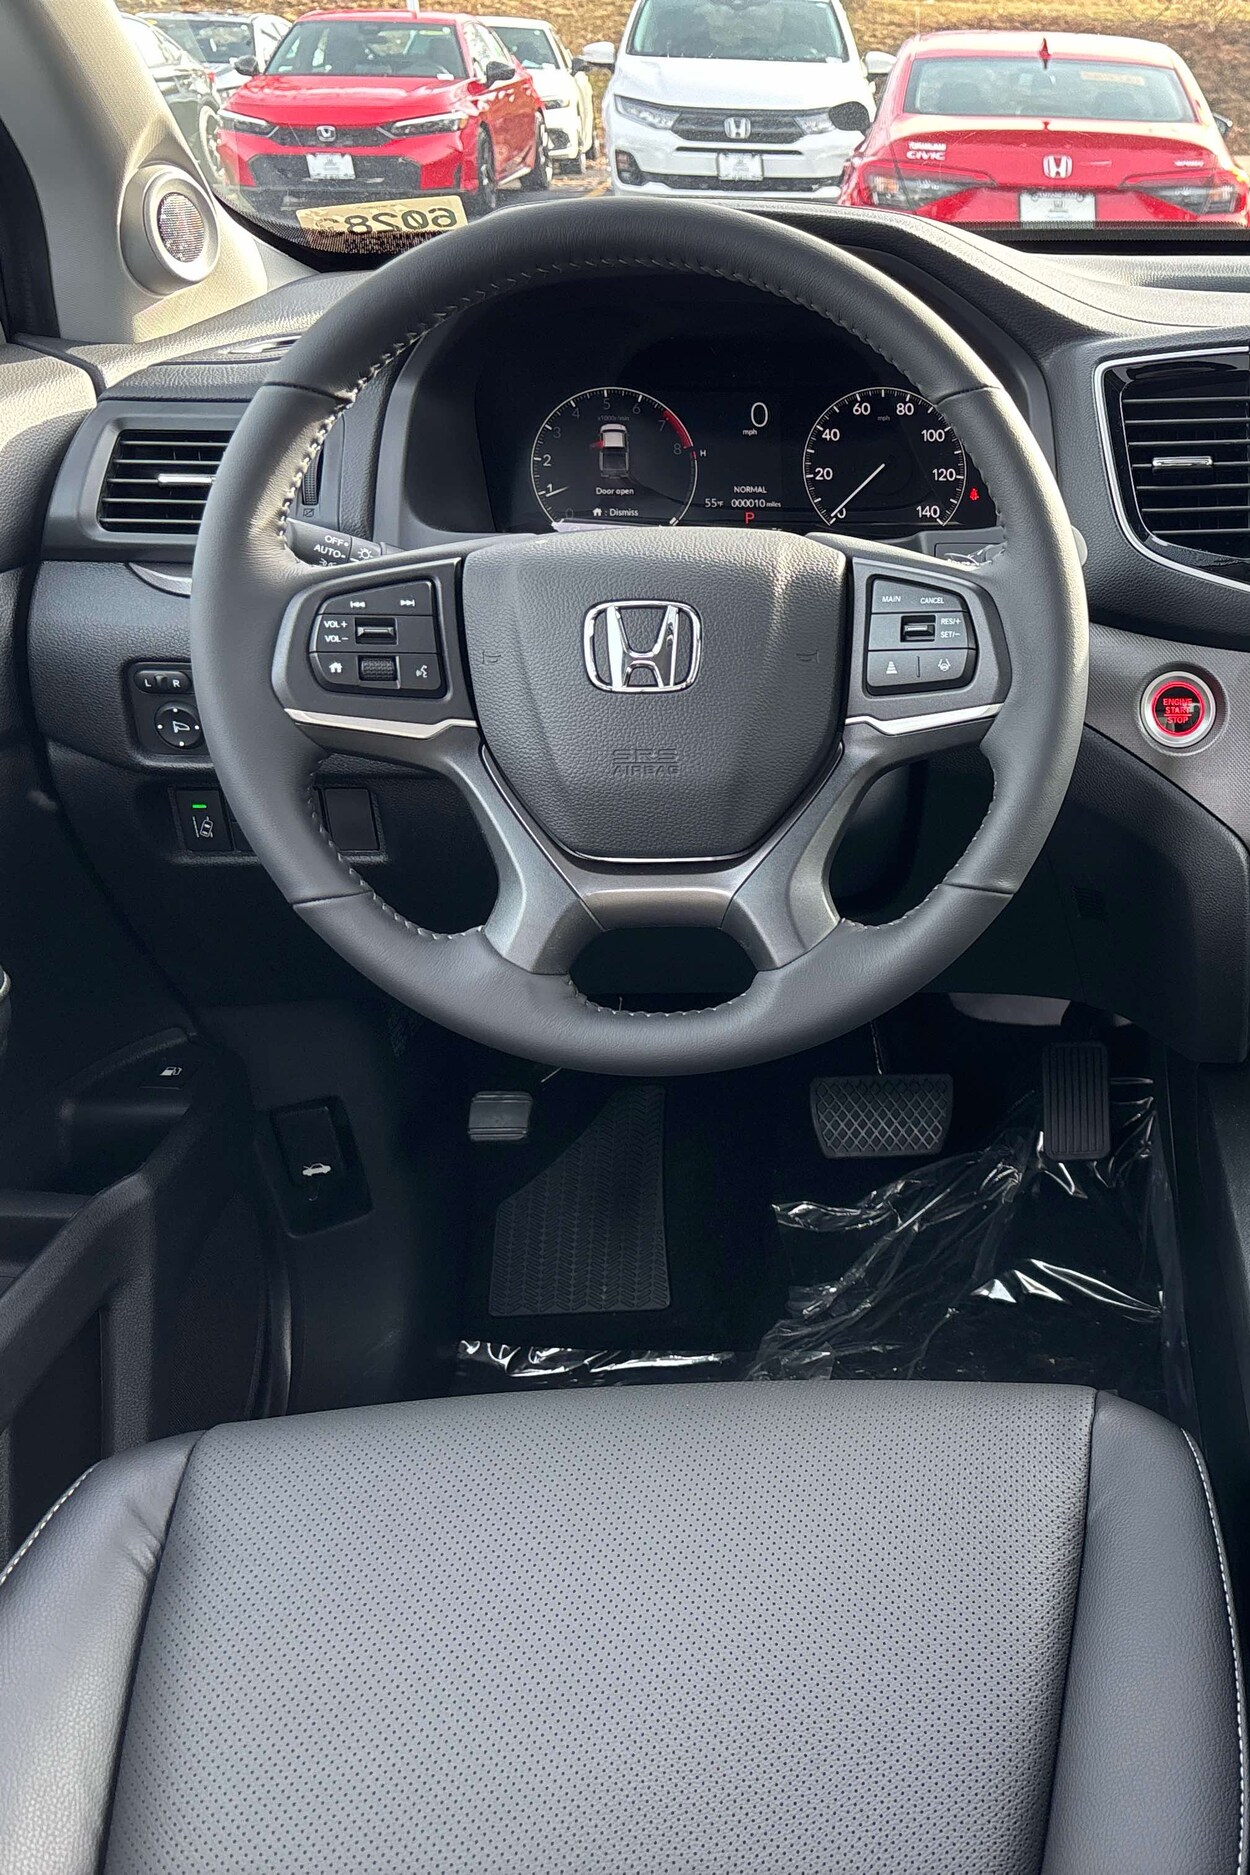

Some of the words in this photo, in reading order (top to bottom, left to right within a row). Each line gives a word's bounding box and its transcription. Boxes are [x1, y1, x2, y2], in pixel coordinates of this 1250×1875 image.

[906, 150, 946, 160] CIVIC
[603, 399, 610, 410] 5
[632, 402, 640, 413] 6
[853, 404, 871, 416] 60
[896, 404, 914, 416] 80
[572, 408, 580, 418] 4
[750, 402, 768, 427] 0
[658, 420, 666, 431] 7
[553, 427, 561, 438] 3
[822, 429, 840, 441] 40
[921, 430, 945, 442] 100
[674, 444, 682, 455] 8
[543, 454, 552, 466] 2
[815, 468, 833, 480] 20
[932, 468, 956, 481] 120
[616, 488, 634, 496] open
[731, 499, 766, 508] 000010
[766, 500, 781, 508] miles
[916, 506, 940, 518] 140
[745, 512, 755, 524] P
[324, 535, 344, 546] OFF
[314, 544, 341, 558] AUTO
[145, 679, 152, 687] L
[612, 748, 678, 763] SRS
[612, 765, 679, 776] AIRBAG
